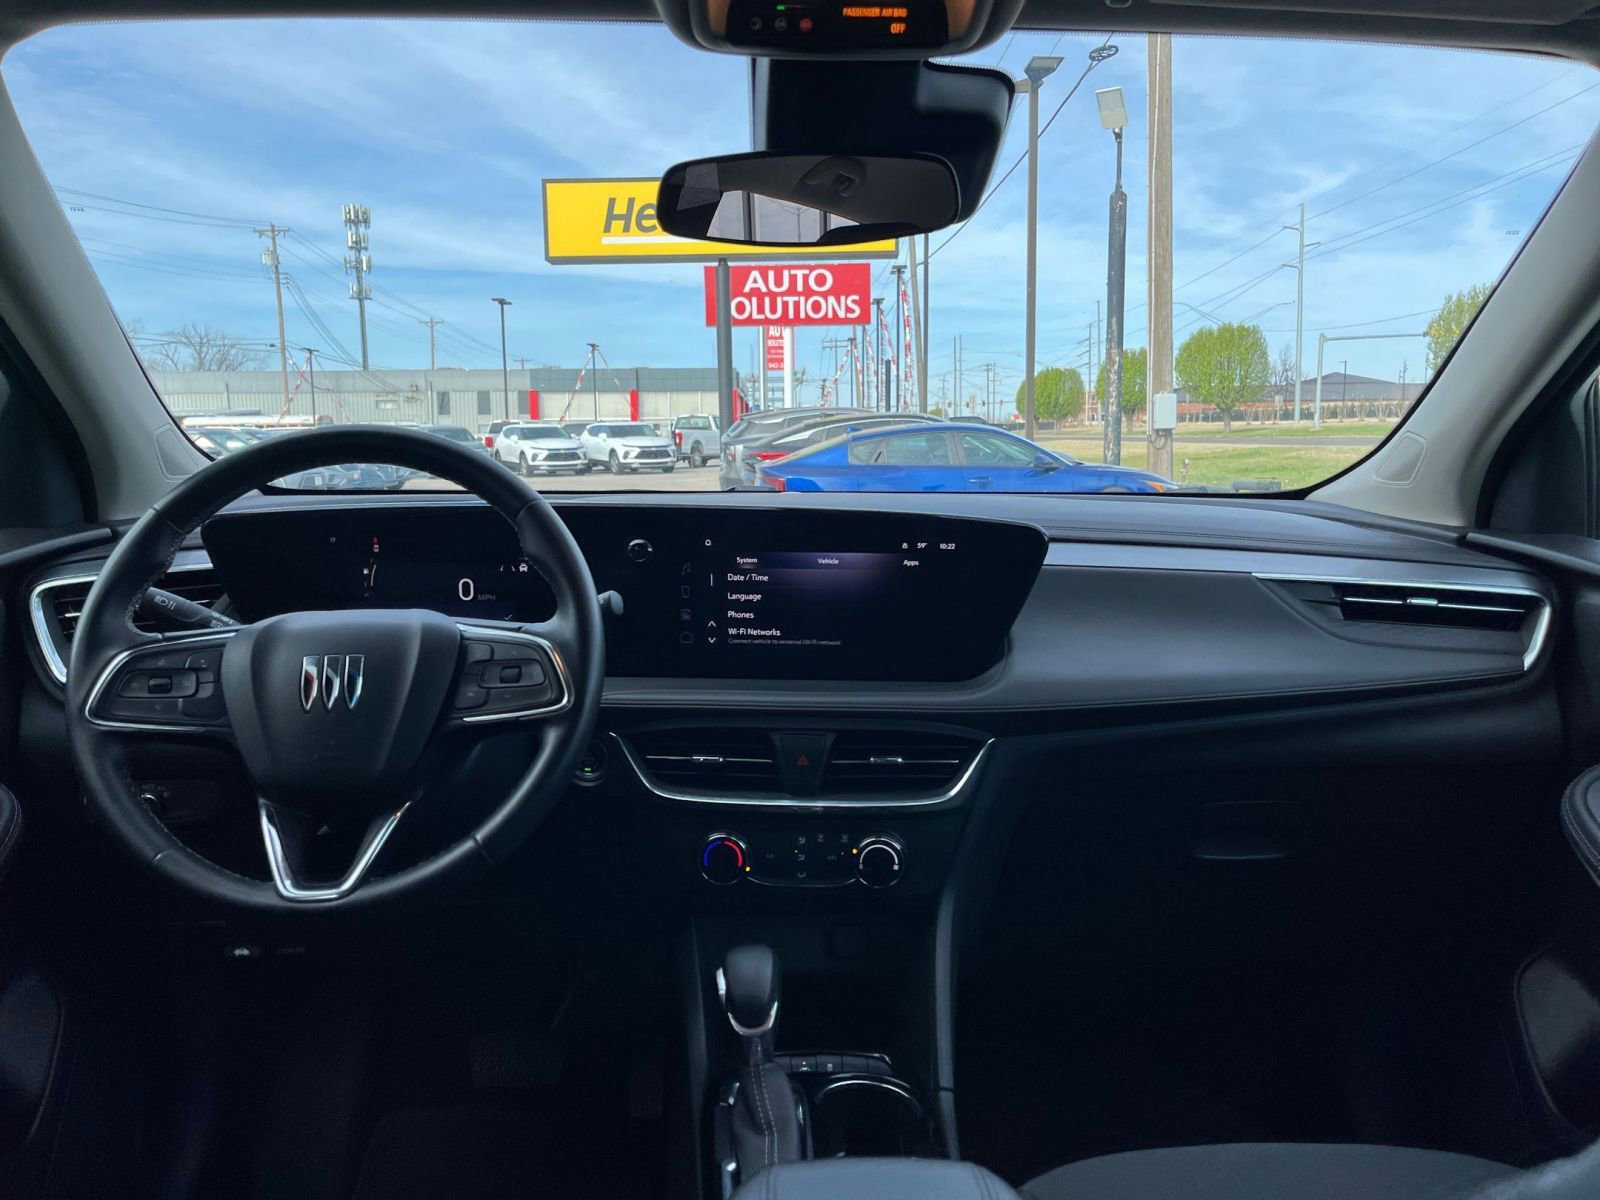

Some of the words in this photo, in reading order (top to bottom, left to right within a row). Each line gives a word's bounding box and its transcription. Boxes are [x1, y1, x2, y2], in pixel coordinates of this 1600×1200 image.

[842, 7, 880, 17] PASSENGER
[890, 23, 906, 34] OFF
[602, 197, 657, 233] He
[743, 269, 833, 293] AUTO
[730, 295, 861, 320] OLUTIONS
[736, 556, 758, 565] System
[903, 559, 919, 567] Apps
[727, 573, 745, 581] Date
[751, 573, 769, 582] Time
[458, 577, 474, 601] 0
[727, 592, 762, 601] Language
[727, 610, 755, 619] Phones
[728, 627, 747, 635] Wi-Fi
[748, 628, 781, 636] Networks
